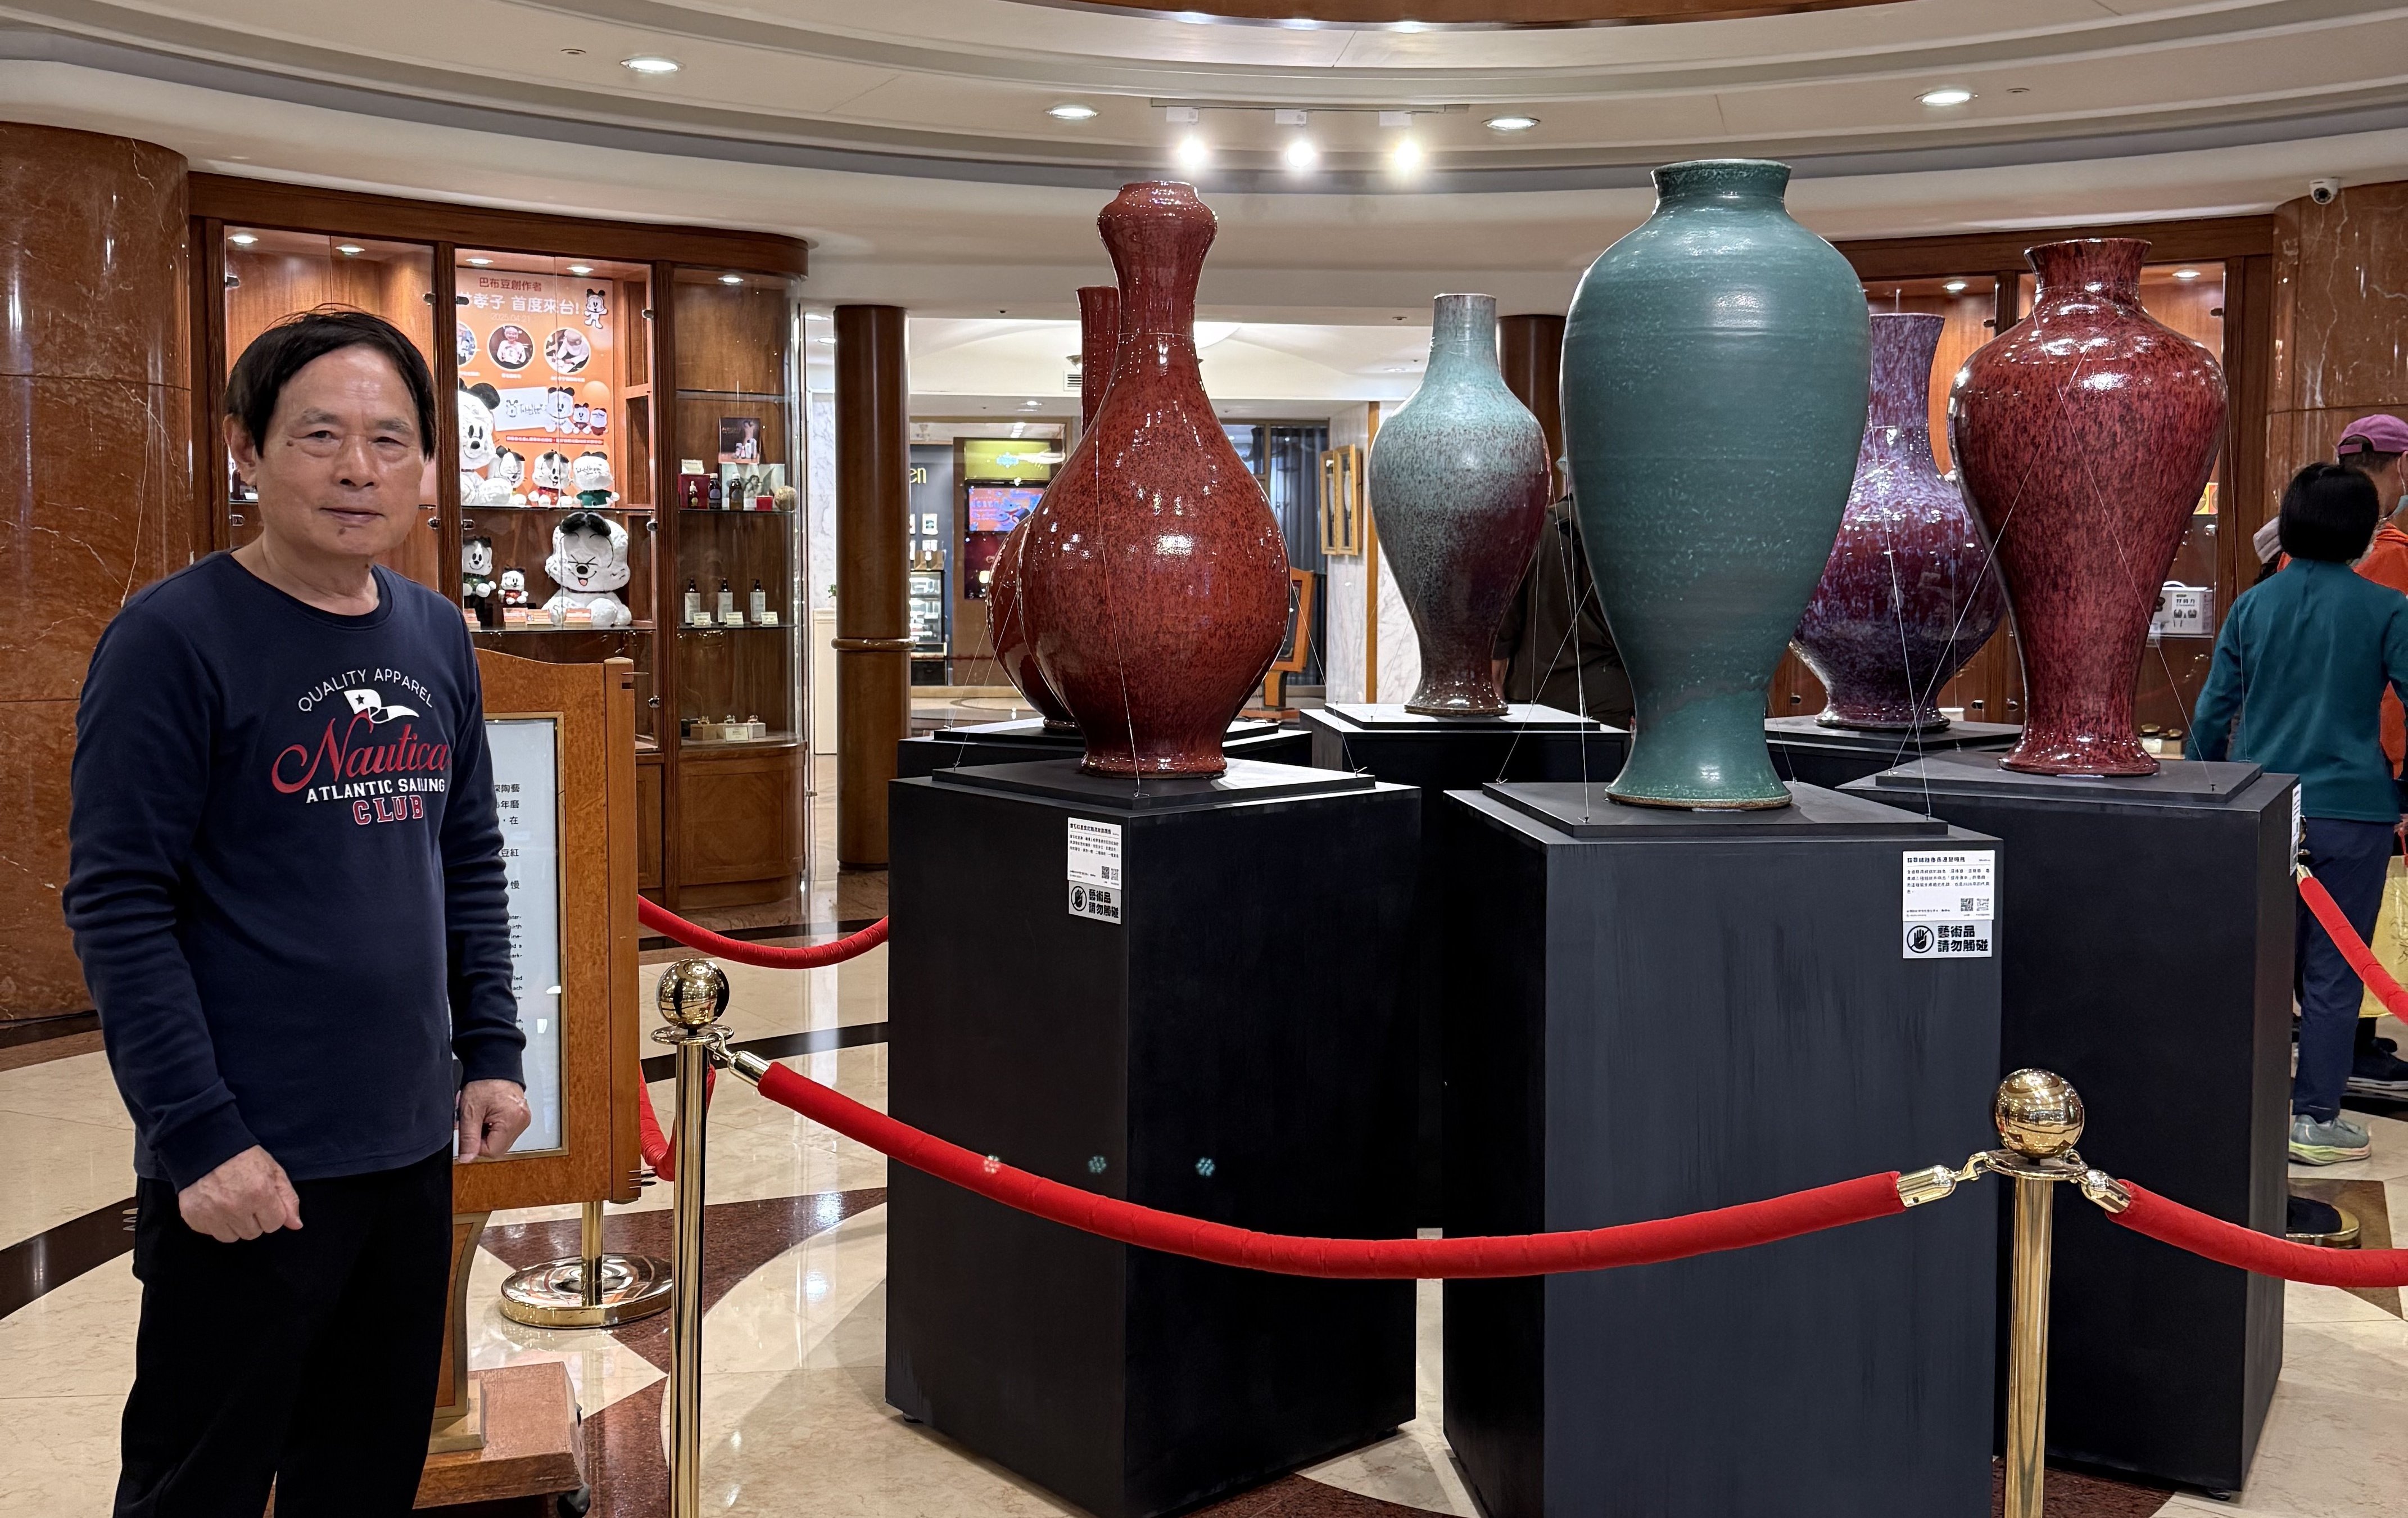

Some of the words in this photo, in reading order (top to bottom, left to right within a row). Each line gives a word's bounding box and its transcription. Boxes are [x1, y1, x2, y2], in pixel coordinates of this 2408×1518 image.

[479, 277, 541, 291] 巴布豆創作者
[511, 296, 579, 315] 首度來台!
[298, 669, 365, 712] QUALITY
[374, 668, 433, 708] APPAREL
[271, 710, 450, 793] Nautica
[306, 779, 393, 803] ATLANTIC
[398, 778, 445, 792] SAILING
[352, 795, 423, 825] CLUB
[1089, 889, 1111, 903] 藝術品
[1089, 902, 1119, 918] 請勿觸碰
[1938, 925, 1975, 938] 藝術品
[1938, 939, 1988, 952] 請勿觸碰
